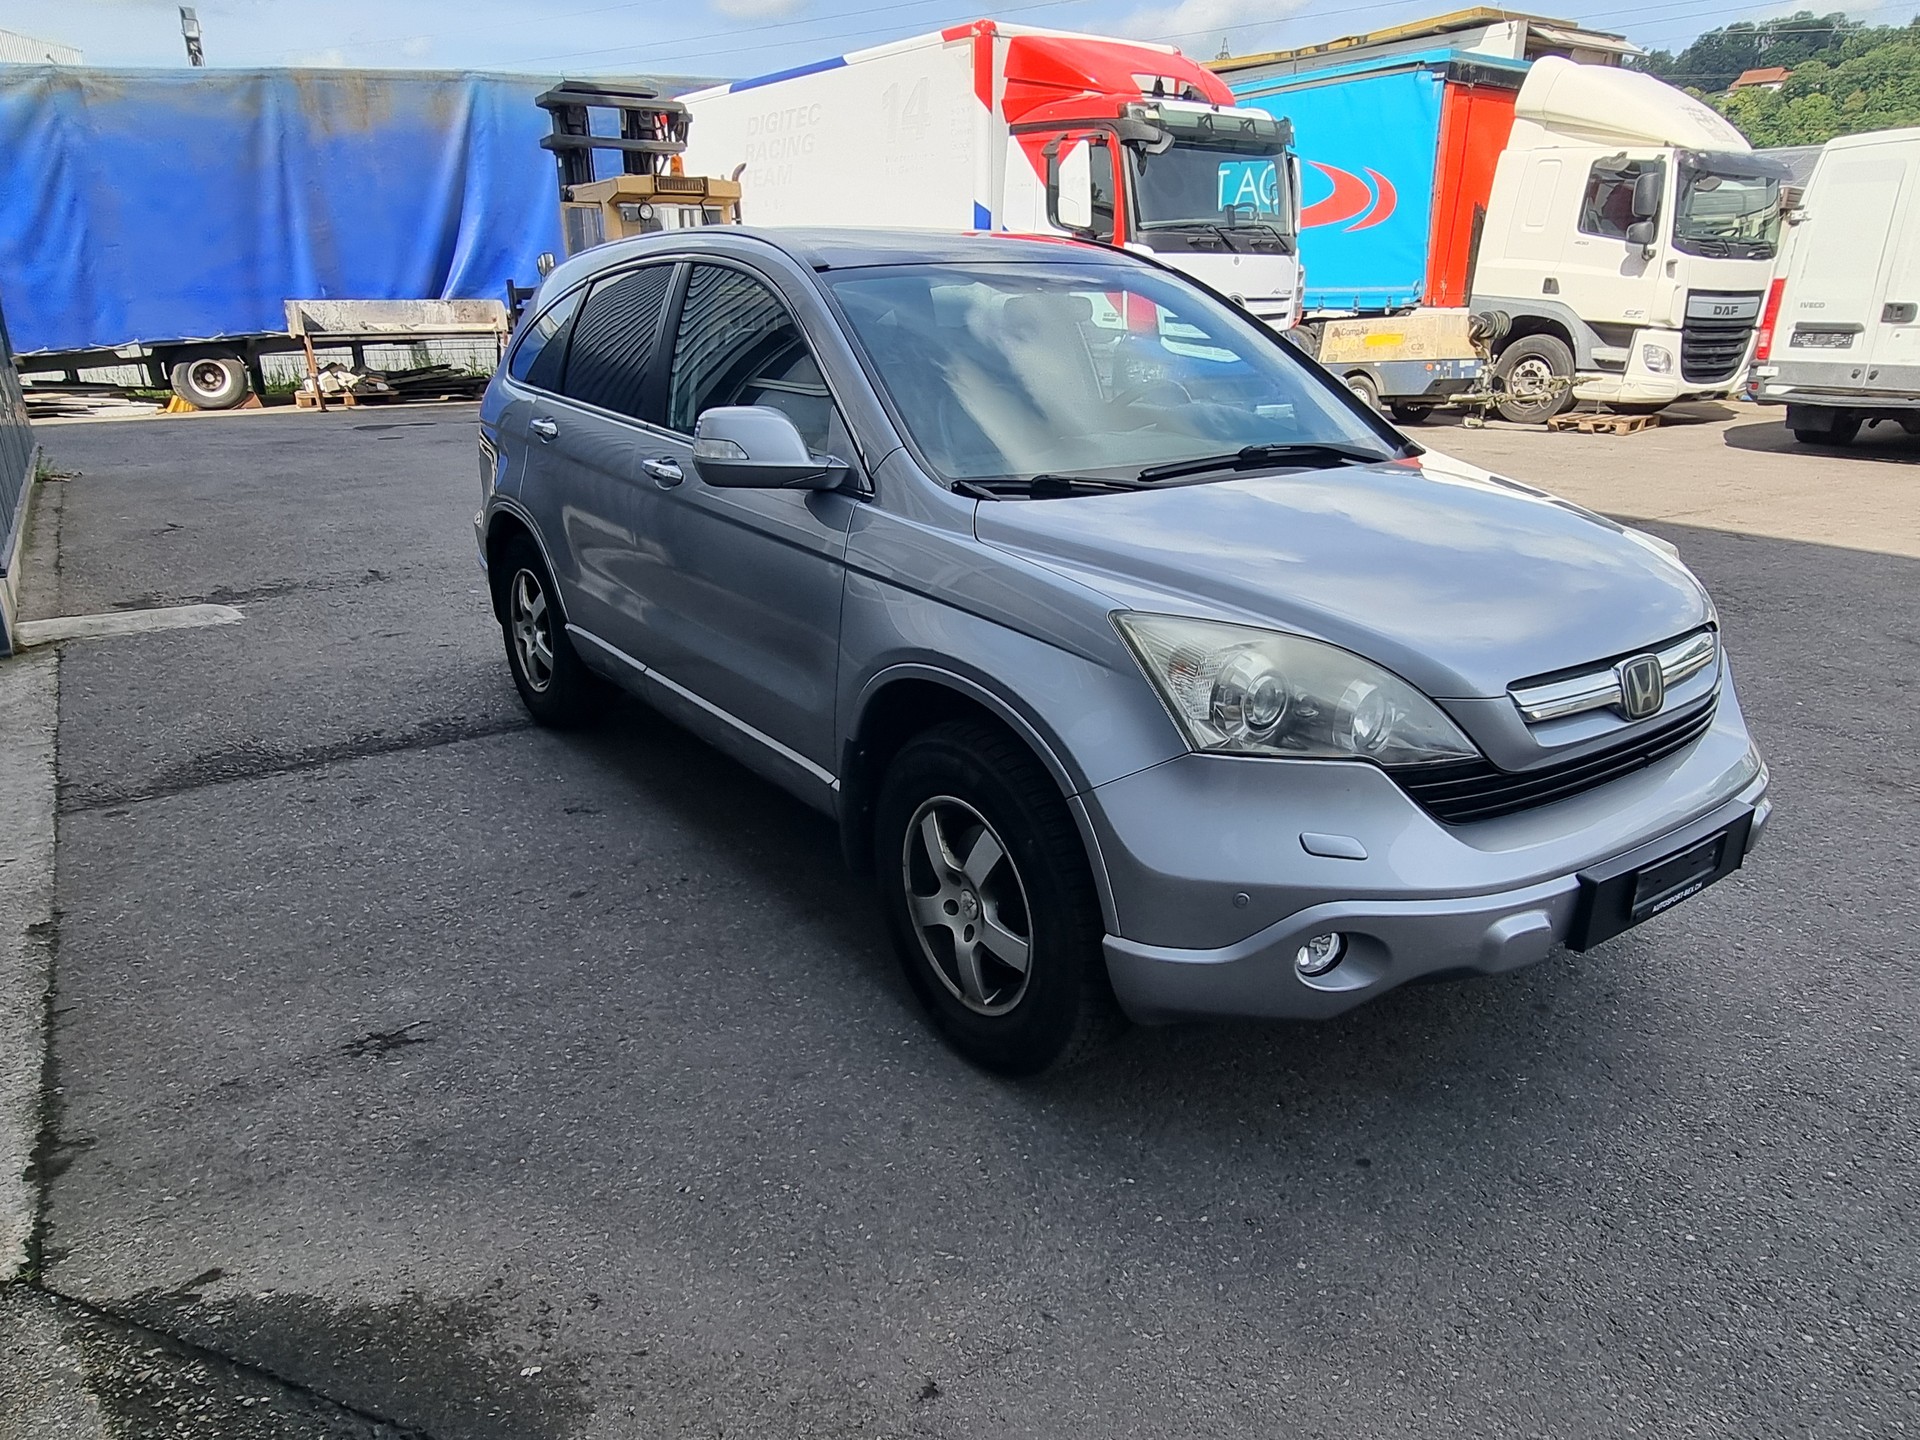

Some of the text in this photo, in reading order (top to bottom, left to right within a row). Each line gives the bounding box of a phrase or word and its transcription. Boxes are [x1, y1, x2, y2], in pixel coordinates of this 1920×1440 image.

[747, 103, 822, 137] DIGITEC
[745, 133, 816, 162] RACING
[744, 163, 792, 188] TEAM
[1713, 305, 1739, 316] DAF
[1800, 301, 1825, 309] IVECO
